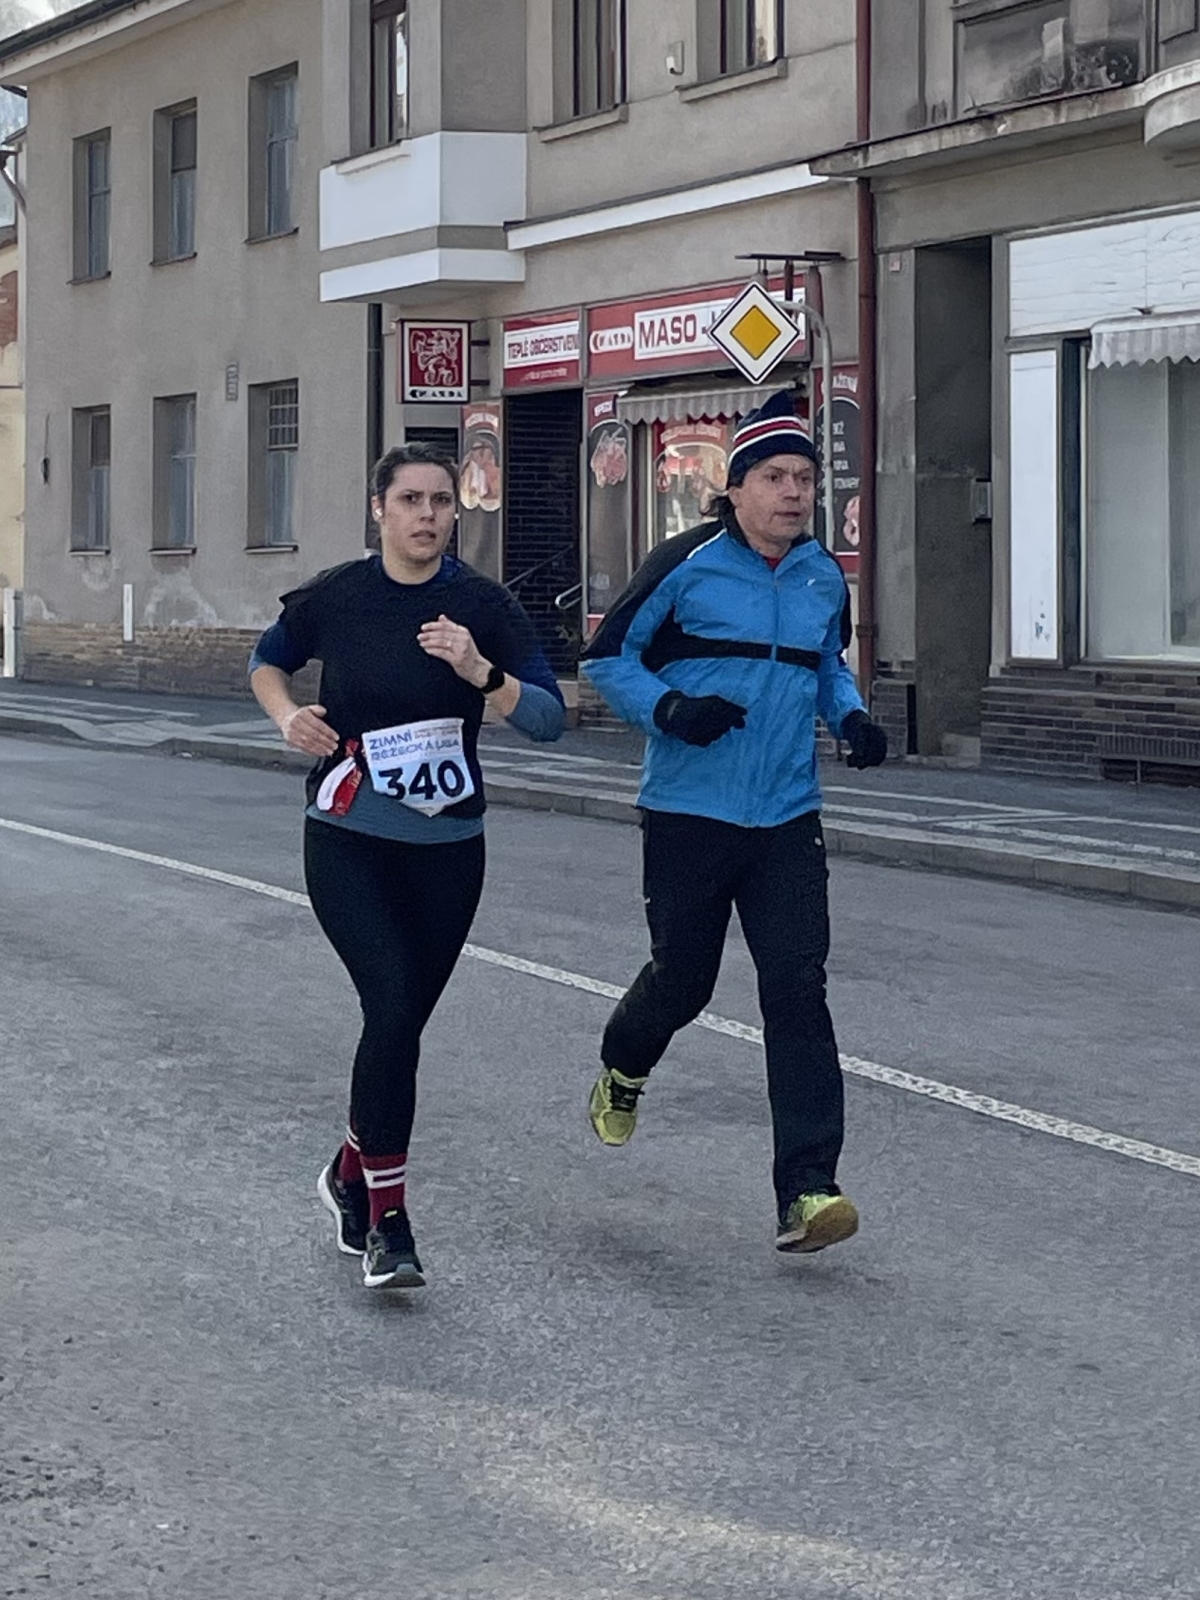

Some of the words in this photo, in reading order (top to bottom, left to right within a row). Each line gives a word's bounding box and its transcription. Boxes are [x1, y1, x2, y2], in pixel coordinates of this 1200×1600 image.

[639, 313, 698, 349] MASO
[369, 729, 413, 750] ZIMNÍ
[378, 759, 466, 800] 340
